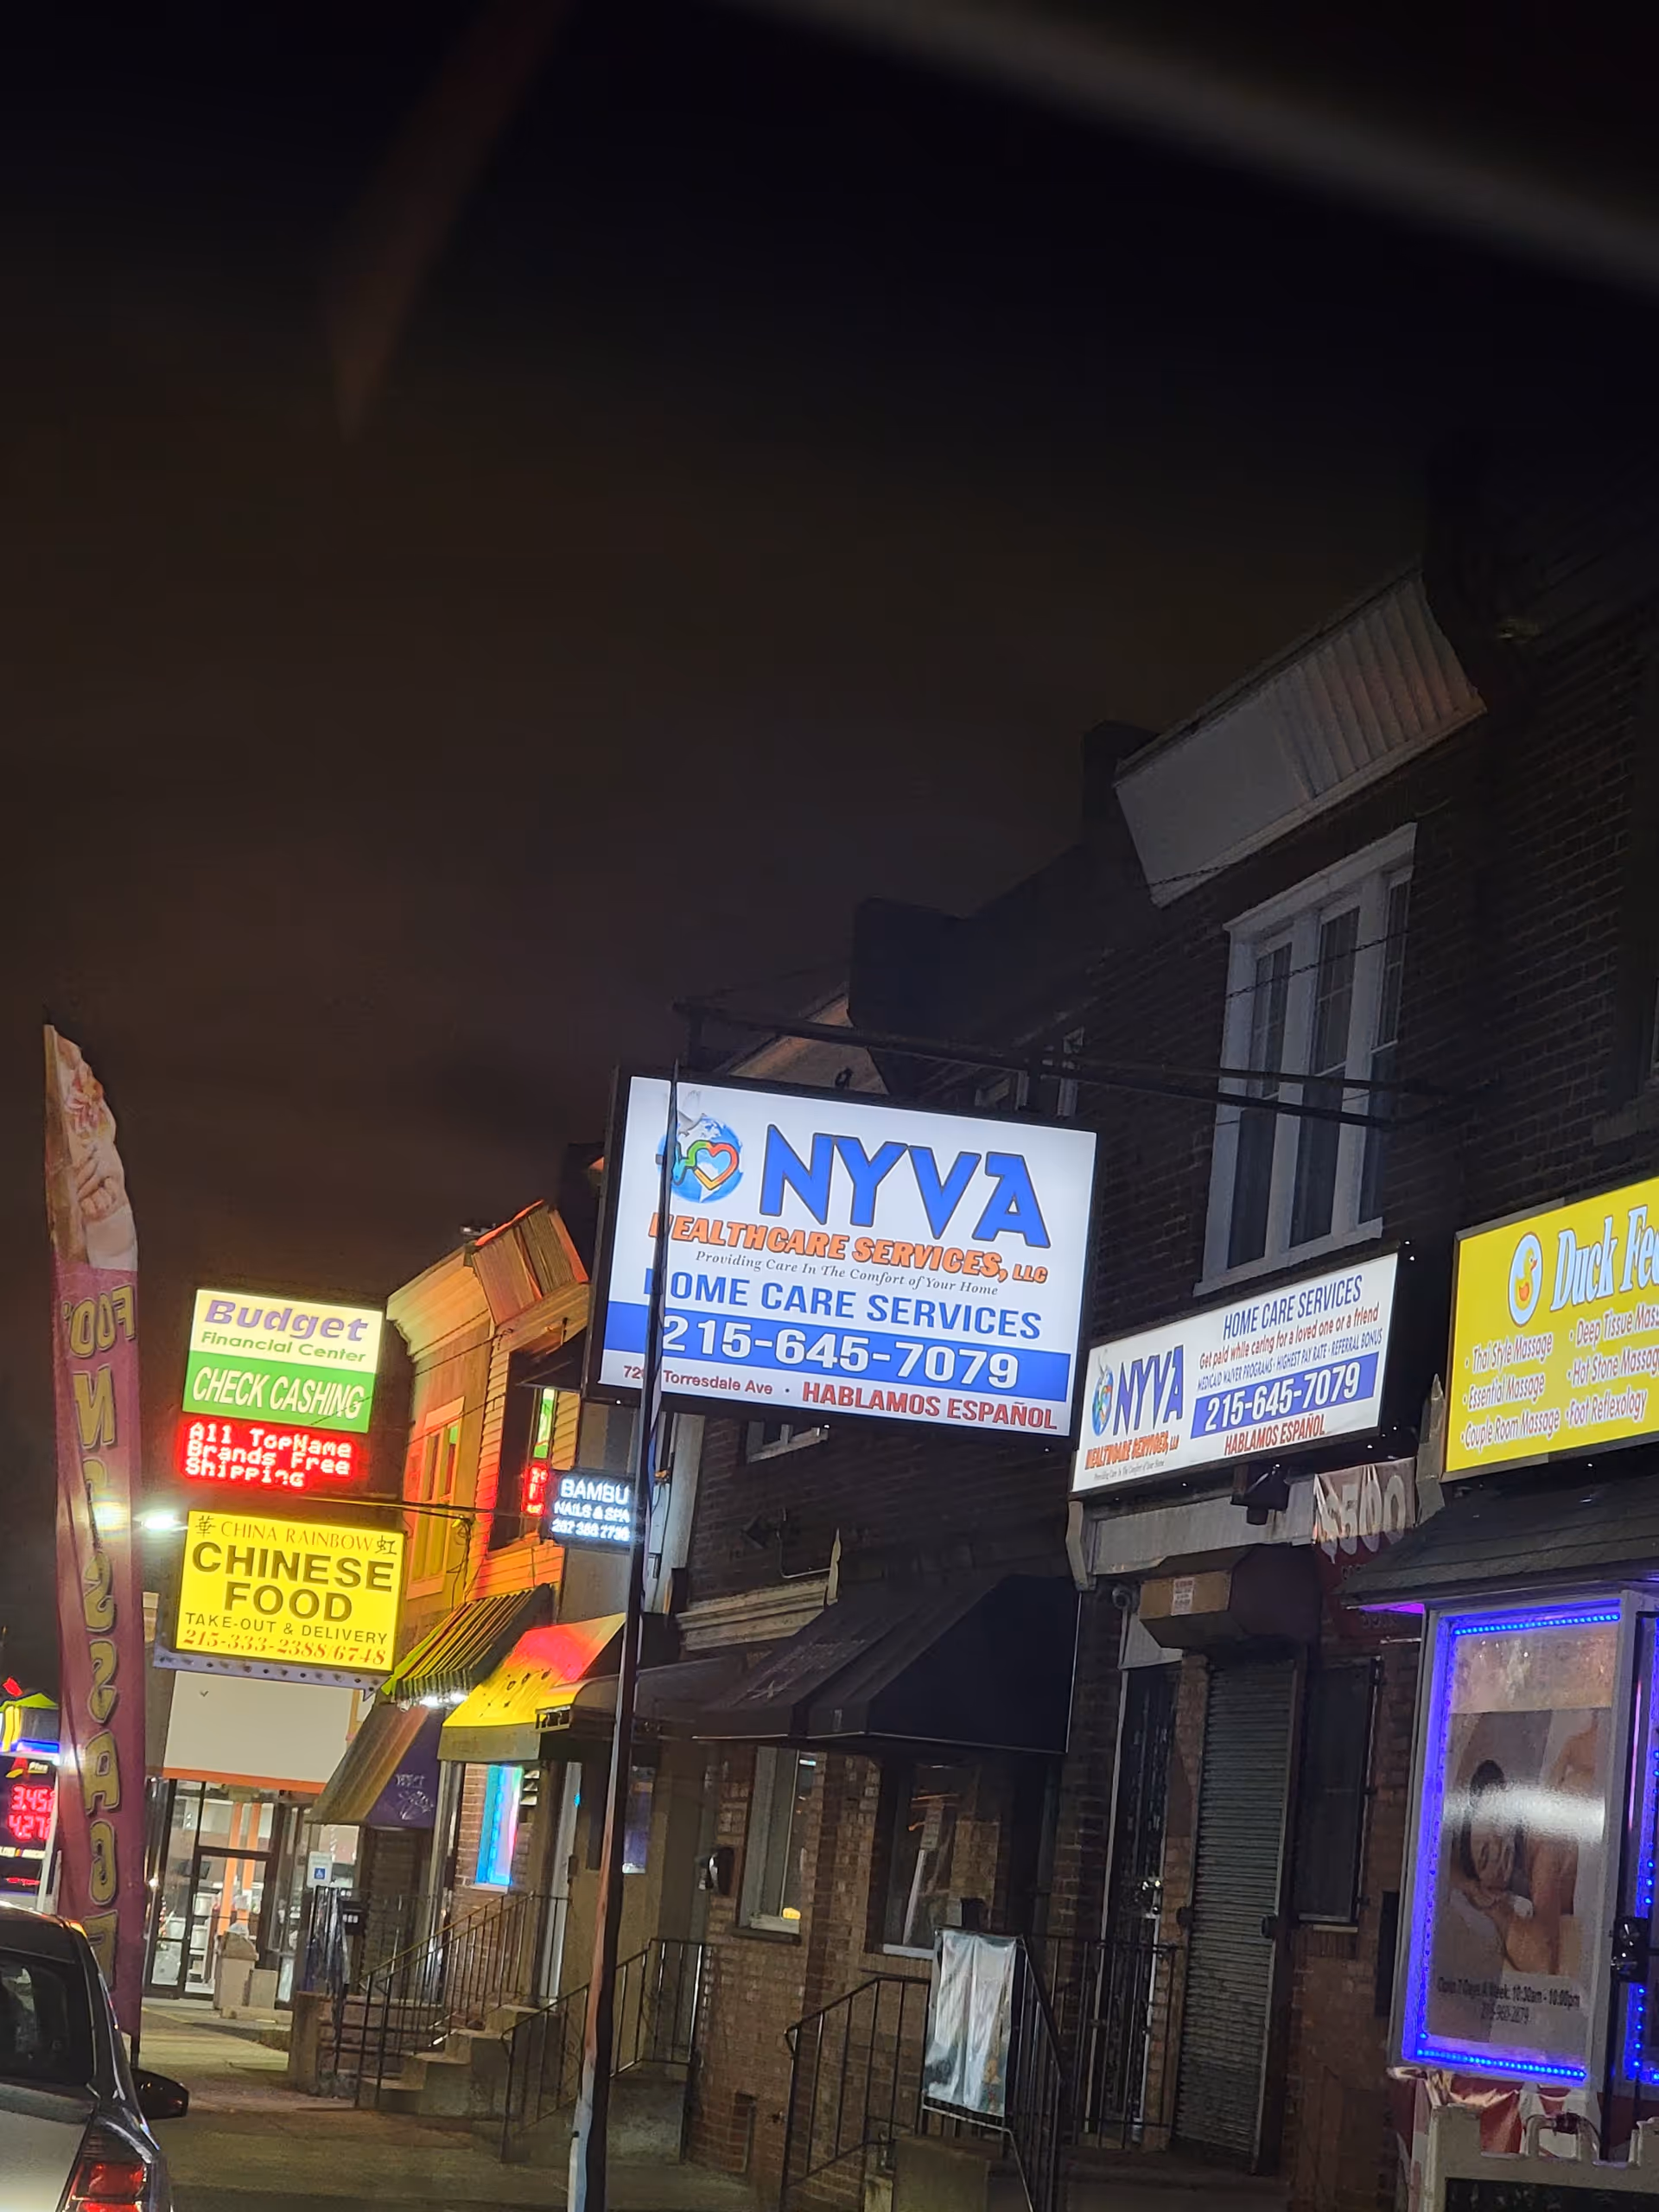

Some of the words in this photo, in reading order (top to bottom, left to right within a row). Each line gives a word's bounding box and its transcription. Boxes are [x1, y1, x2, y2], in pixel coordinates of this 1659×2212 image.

[759, 1123, 1051, 1248] NYVA
[696, 1250, 763, 1271] Providing
[766, 1255, 799, 1273] Care
[802, 1261, 818, 1274] In
[820, 1263, 847, 1277] The
[849, 1266, 906, 1287] Comfort
[908, 1274, 925, 1290] of
[925, 1276, 957, 1293] Your
[960, 1281, 999, 1296] Home
[852, 1236, 1008, 1284] SERVICES,
[1013, 1264, 1048, 1284] LLC
[1550, 1216, 1618, 1312] Duck
[205, 1300, 369, 1341] Budget
[760, 1281, 856, 1319] CARE
[867, 1295, 1042, 1340] SERVICES
[1224, 1306, 1258, 1340] HOME
[1261, 1296, 1295, 1328] CARE
[1297, 1274, 1363, 1315] SERVICES
[200, 1331, 292, 1355] Financial
[300, 1344, 366, 1363] Center
[1199, 1351, 1214, 1370] Get
[1212, 1345, 1230, 1367] paid
[1230, 1342, 1249, 1361] while
[1251, 1336, 1275, 1357] caring
[1275, 1332, 1287, 1349] for
[1288, 1334, 1294, 1344] a
[1295, 1325, 1318, 1344] loved
[1319, 1323, 1334, 1336] one
[1336, 1317, 1346, 1332] or
[1347, 1317, 1352, 1328] a
[1353, 1301, 1380, 1326] friend
[1577, 1319, 1600, 1348] Deep
[1603, 1310, 1633, 1338] Tissue
[662, 1314, 1019, 1389] 215-645-7079
[1197, 1370, 1223, 1391] MEDICAID
[1243, 1358, 1274, 1379] PROGRAMS
[1275, 1352, 1300, 1370] HIGHEST
[1300, 1347, 1313, 1362] PAY
[1313, 1344, 1327, 1360] RATE
[1331, 1337, 1360, 1356] REFERRAL
[1361, 1328, 1382, 1348] BONUS
[1472, 1344, 1491, 1372] Thai
[1491, 1338, 1512, 1370] Style
[1513, 1332, 1553, 1361] Massage
[1573, 1360, 1590, 1384] Hot
[1592, 1353, 1618, 1380] Stone
[192, 1365, 271, 1408] CHECK
[269, 1376, 365, 1421] CASHING
[623, 1365, 645, 1382] 72
[664, 1370, 741, 1391] Torresdale
[745, 1380, 773, 1395] Ave
[802, 1382, 941, 1417] HABLAMOS
[947, 1398, 1058, 1431] ESPAÑOL
[1113, 1344, 1184, 1436] NYVA
[1205, 1361, 1361, 1432] 215-645-7079
[1469, 1377, 1506, 1408] Essential
[1507, 1373, 1545, 1402] Massage
[1569, 1399, 1591, 1424] Foot
[1592, 1386, 1647, 1421] Reflexology
[188, 1422, 232, 1444] All
[251, 1428, 353, 1459] TopName
[1224, 1424, 1279, 1456] HABLAMOS
[1280, 1413, 1326, 1445] ESPAÑOL
[1465, 1421, 1493, 1451] Couple
[1495, 1415, 1519, 1438] Room
[1521, 1408, 1560, 1438] Massage
[185, 1459, 305, 1488] Shipping
[187, 1440, 276, 1466] Brands
[290, 1451, 351, 1477] Free
[554, 1501, 592, 1518] NAILS
[593, 1505, 603, 1519] &
[604, 1507, 631, 1522] SPA
[561, 1478, 629, 1505] BAMBU
[194, 1516, 216, 1538] 華
[220, 1522, 277, 1543] CHINA
[285, 1528, 375, 1554] RAINBOW
[375, 1535, 398, 1555] 虹
[192, 1541, 394, 1592] CHINESE
[224, 1582, 353, 1623] FOOD
[183, 1630, 386, 1666] 215-333-2388/6748
[185, 1612, 276, 1635] TAKE-OUT
[283, 1623, 294, 1635] &
[301, 1625, 389, 1645] DELIVERY
